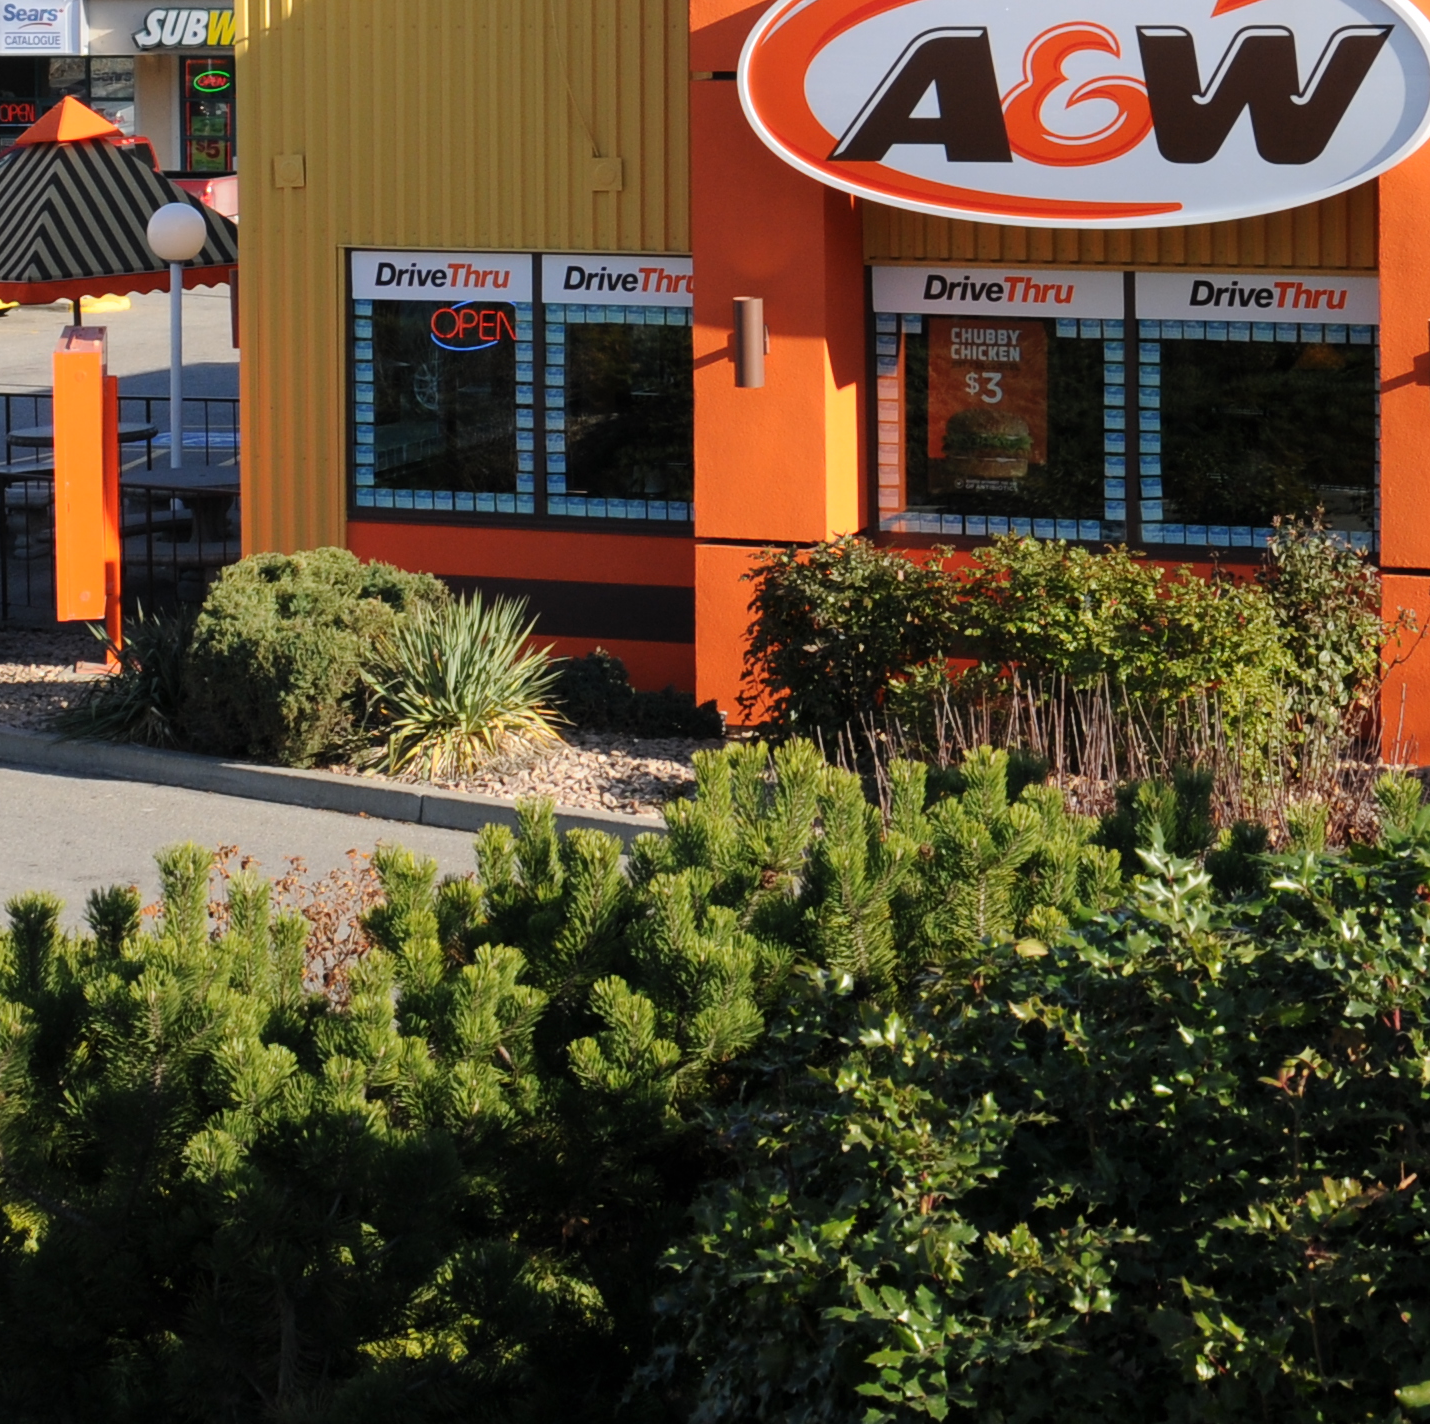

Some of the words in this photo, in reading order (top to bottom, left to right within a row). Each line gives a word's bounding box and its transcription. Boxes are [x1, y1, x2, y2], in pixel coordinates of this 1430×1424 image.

[3, 3, 58, 23] Sears
[133, 8, 236, 48] SUBW
[4, 35, 61, 46] CATALOGUE
[198, 76, 228, 87] OPEN
[825, 20, 1395, 167] A&W
[0, 103, 36, 122] OPEN
[431, 307, 517, 340] OPEN
[951, 328, 1020, 345] CHUBBY
[951, 345, 1020, 362] CHICKEN
[965, 371, 1003, 404] $3
